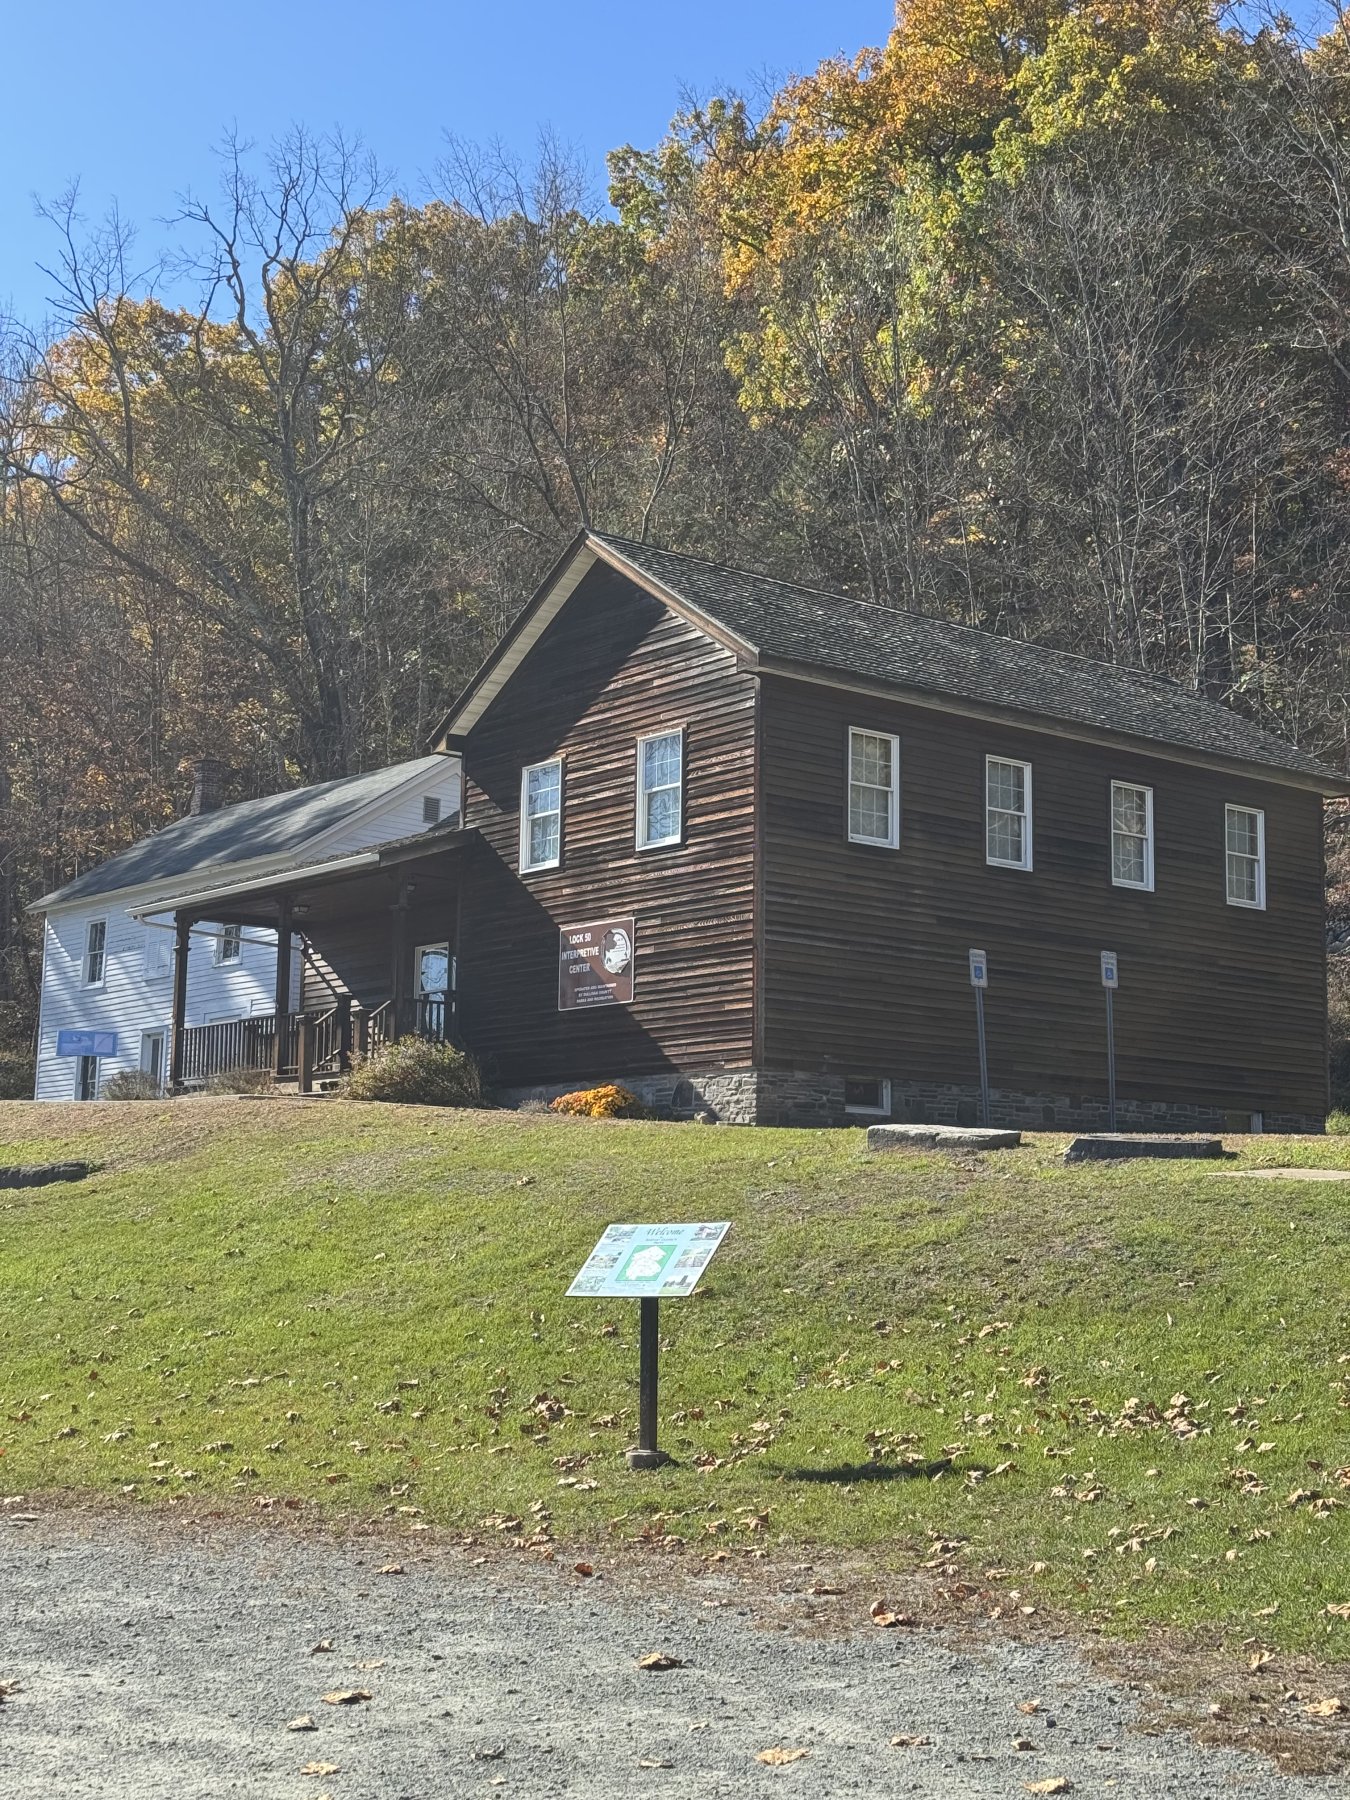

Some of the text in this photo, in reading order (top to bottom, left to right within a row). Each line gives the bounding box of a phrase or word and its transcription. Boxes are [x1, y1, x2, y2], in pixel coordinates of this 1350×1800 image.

[569, 932, 591, 944] LOCK 50
[562, 946, 599, 960] INTERPRETIVE
[569, 963, 590, 974] CENTER
[646, 1226, 685, 1235] Welcome
